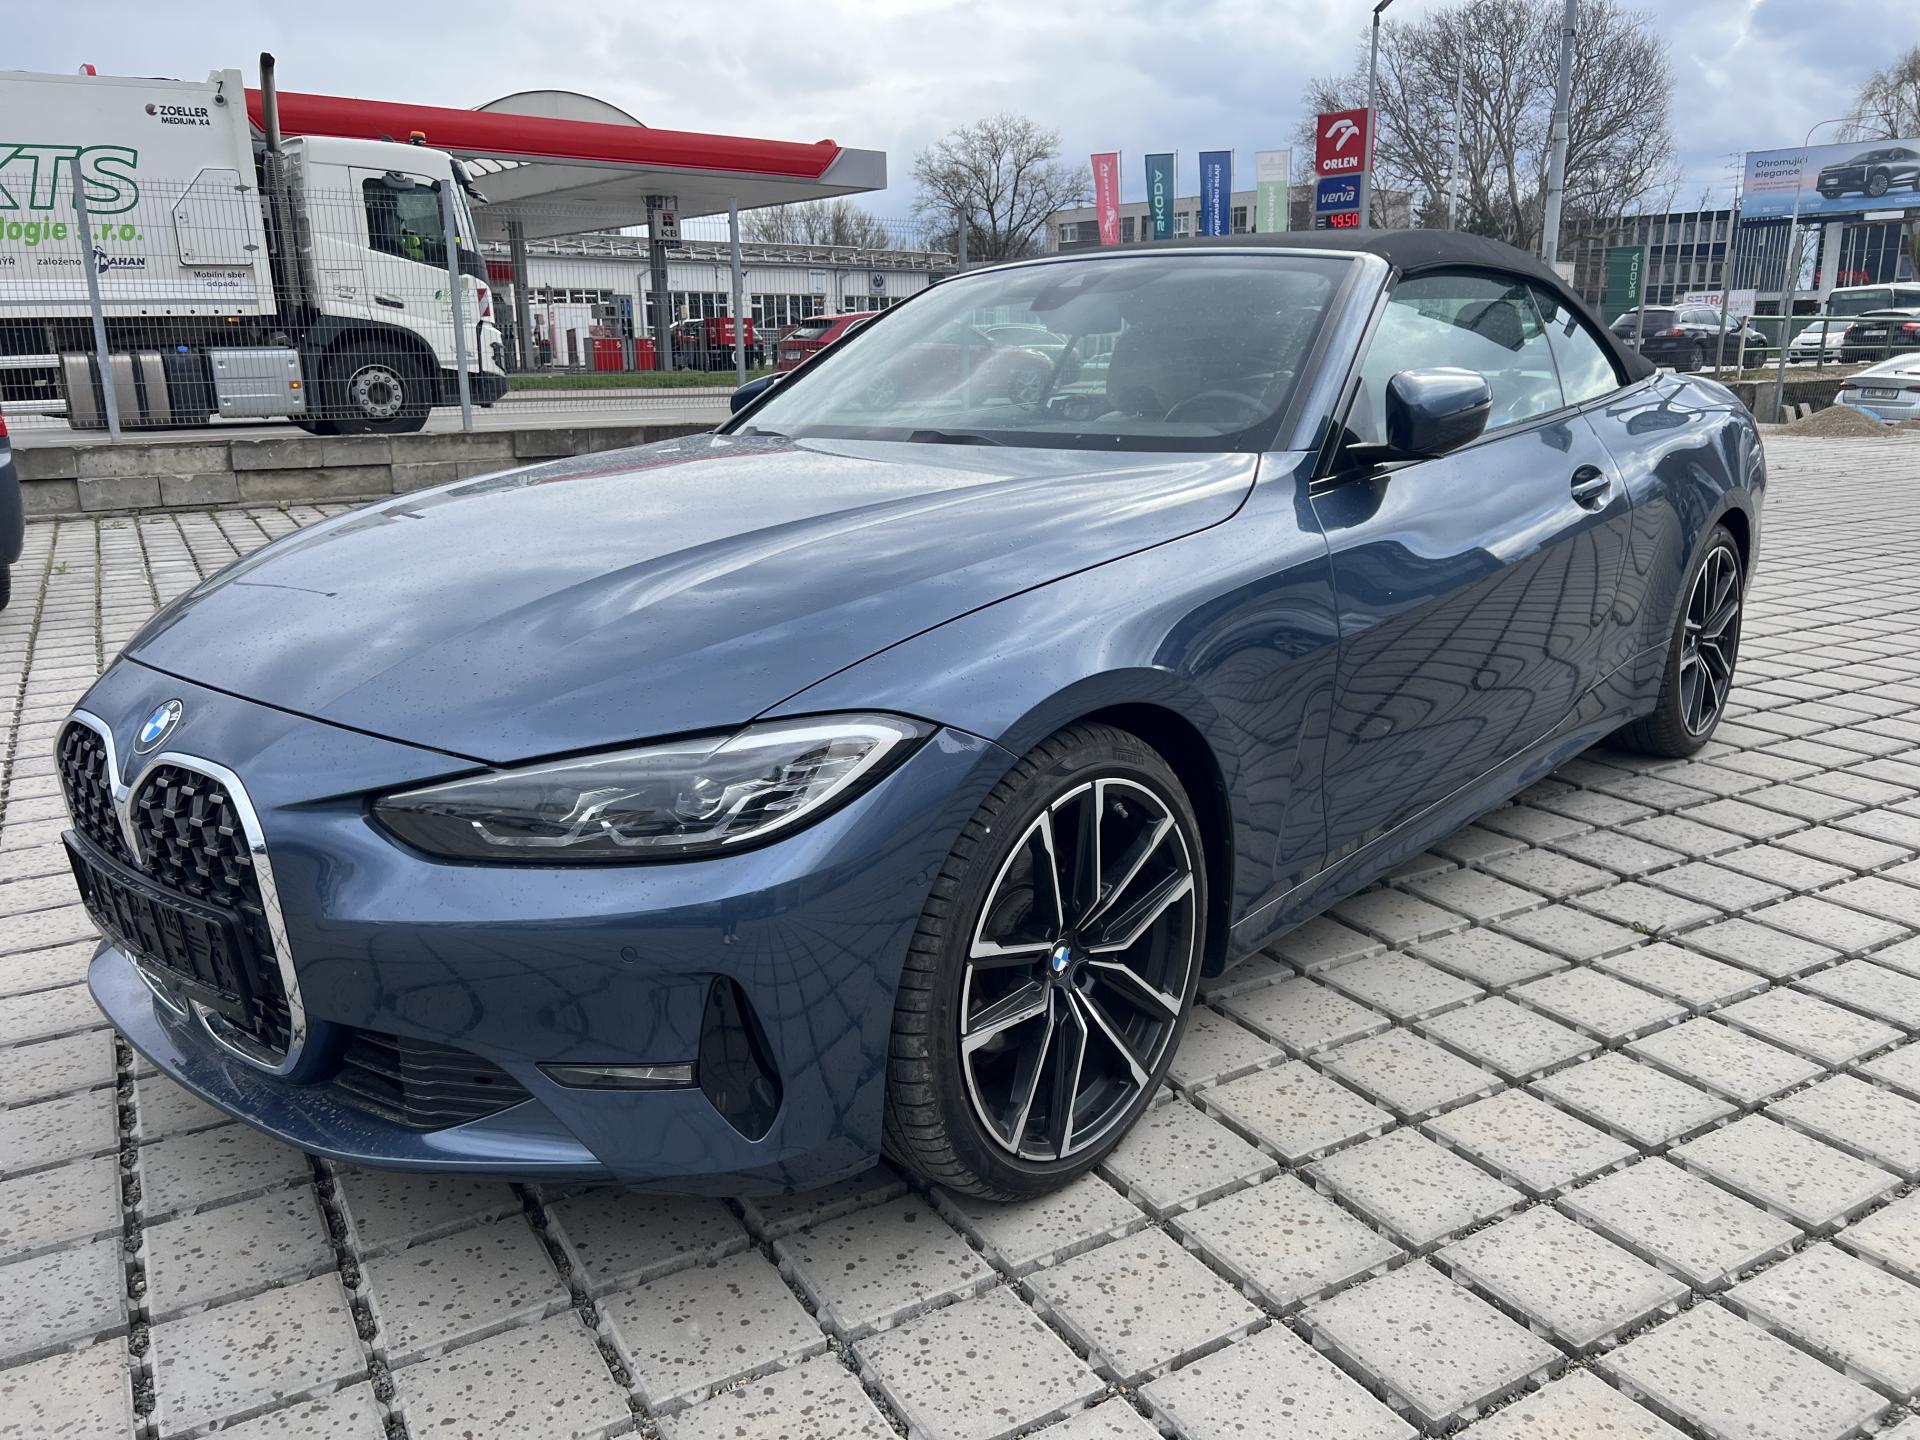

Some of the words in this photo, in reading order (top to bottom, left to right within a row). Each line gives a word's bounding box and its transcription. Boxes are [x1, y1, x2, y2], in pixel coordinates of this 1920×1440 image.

[159, 105, 208, 117] ZOELLER
[161, 117, 197, 126] MEDIUM
[199, 118, 211, 126] X4
[1323, 156, 1358, 170] ORLEN
[1754, 167, 1801, 180] elegance
[1321, 191, 1355, 204] verva
[1331, 212, 1359, 228] 49.50
[77, 223, 143, 241] .r.o.
[661, 229, 677, 238] KB
[1815, 270, 1870, 284] STRA
